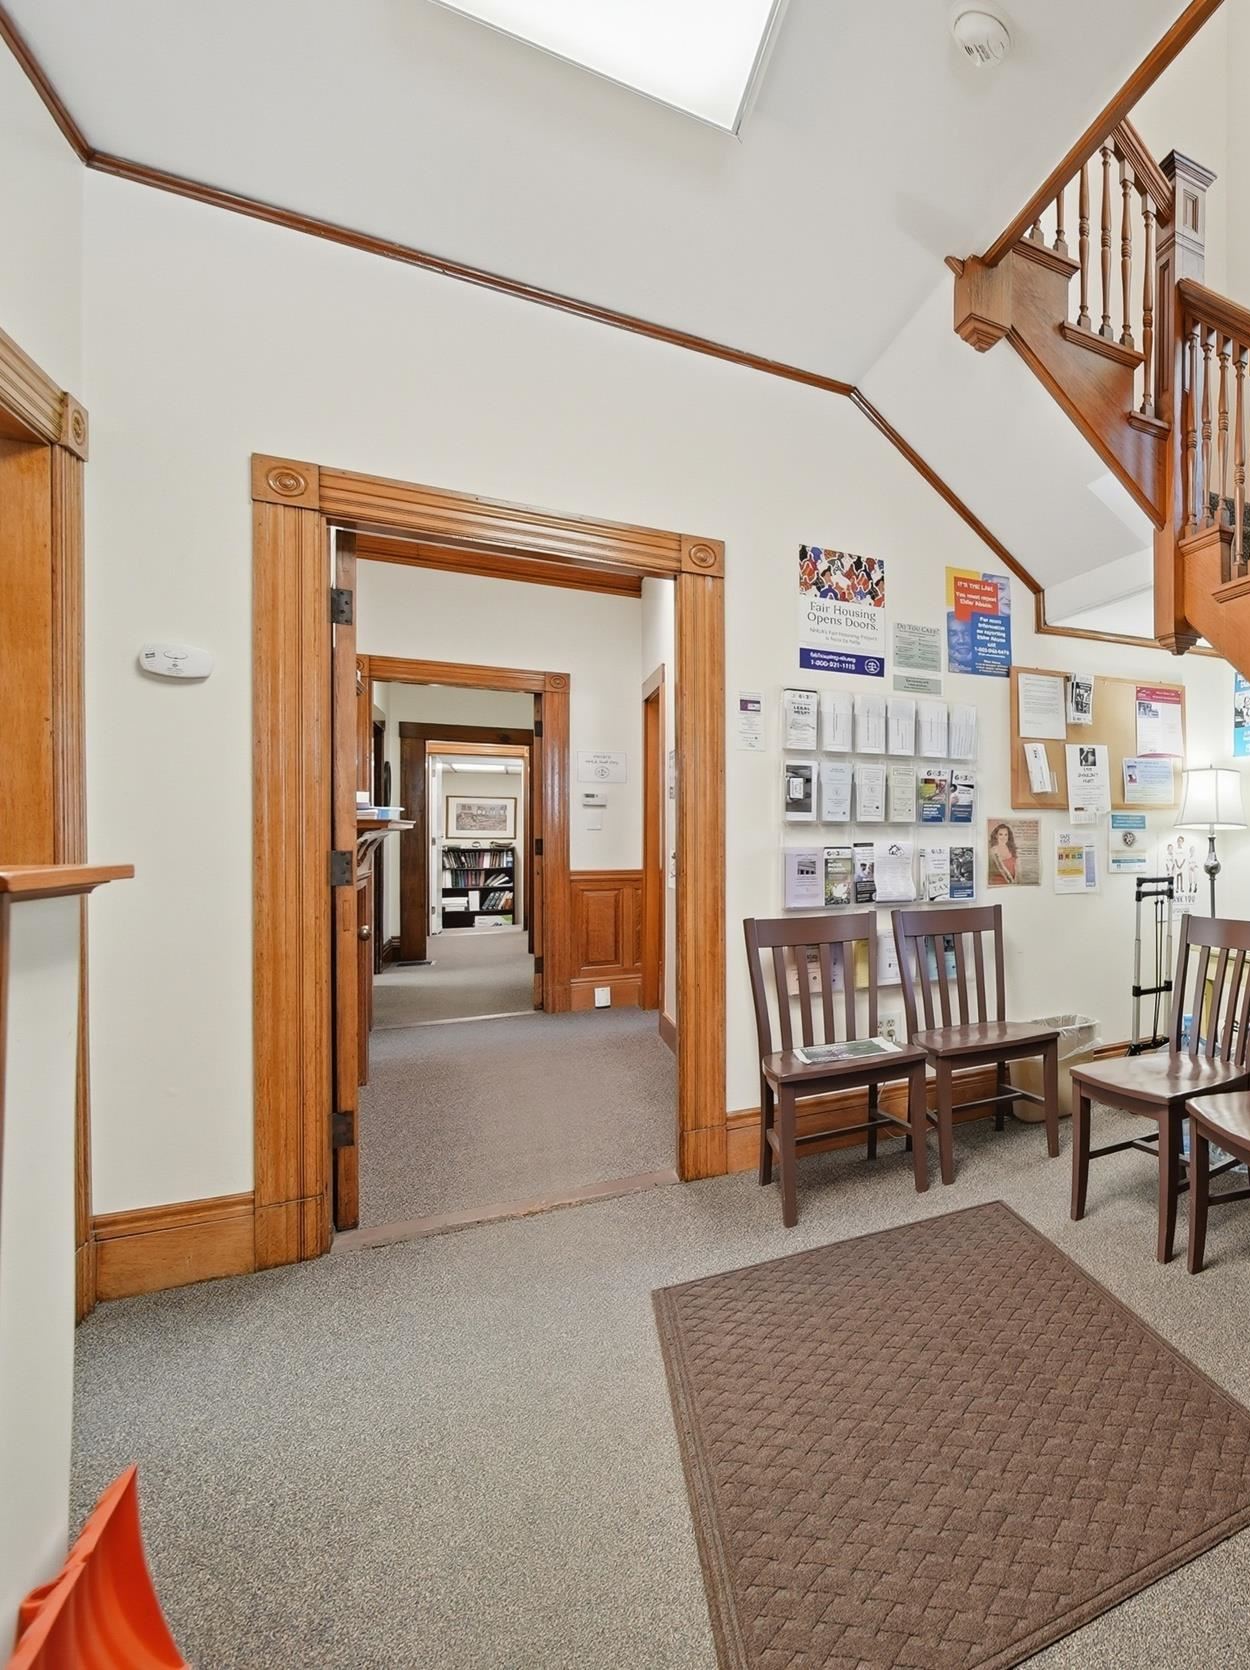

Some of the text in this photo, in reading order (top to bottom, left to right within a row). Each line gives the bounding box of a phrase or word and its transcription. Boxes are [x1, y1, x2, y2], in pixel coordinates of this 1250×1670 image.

[807, 611, 879, 631] Opens Doors.
[810, 601, 876, 623] Fair Housing
